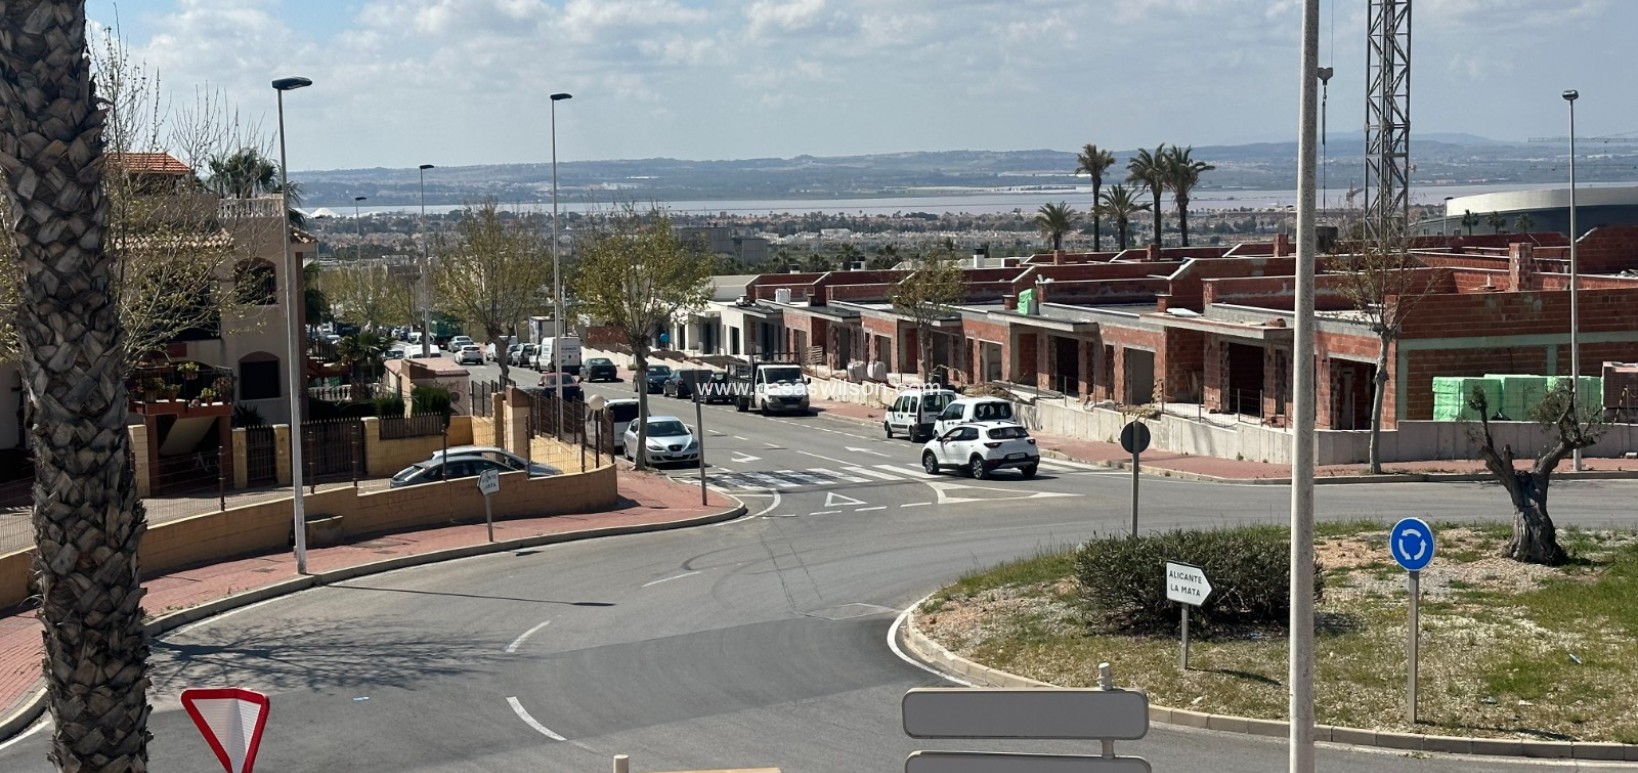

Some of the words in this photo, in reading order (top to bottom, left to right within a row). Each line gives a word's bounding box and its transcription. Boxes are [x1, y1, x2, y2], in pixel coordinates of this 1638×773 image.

[1169, 570, 1202, 584] ALICANTE
[1170, 584, 1179, 592] LA
[1181, 586, 1201, 597] MATA
